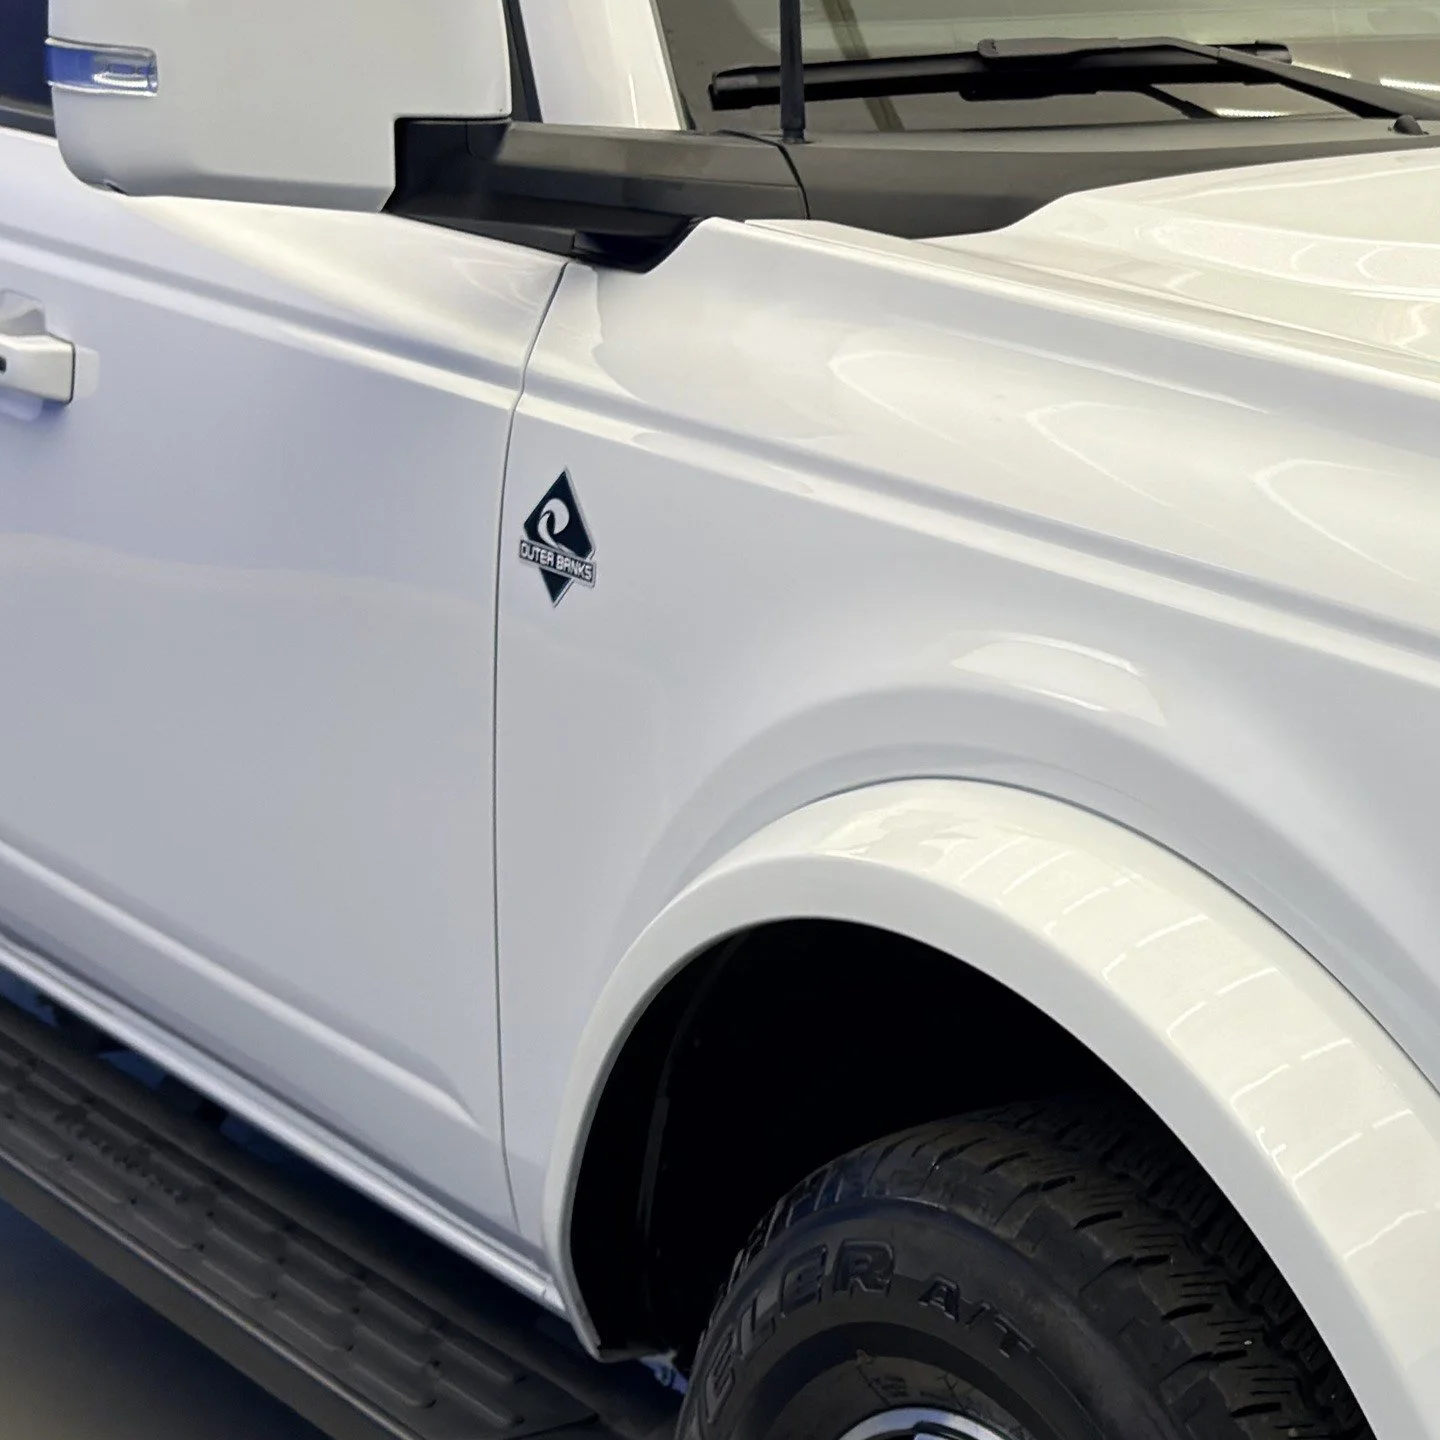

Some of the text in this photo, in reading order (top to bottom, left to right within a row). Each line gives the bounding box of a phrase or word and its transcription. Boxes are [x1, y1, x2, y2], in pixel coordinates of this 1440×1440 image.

[521, 543, 592, 580] OUTER BANKS
[917, 1272, 1037, 1359] A/T
